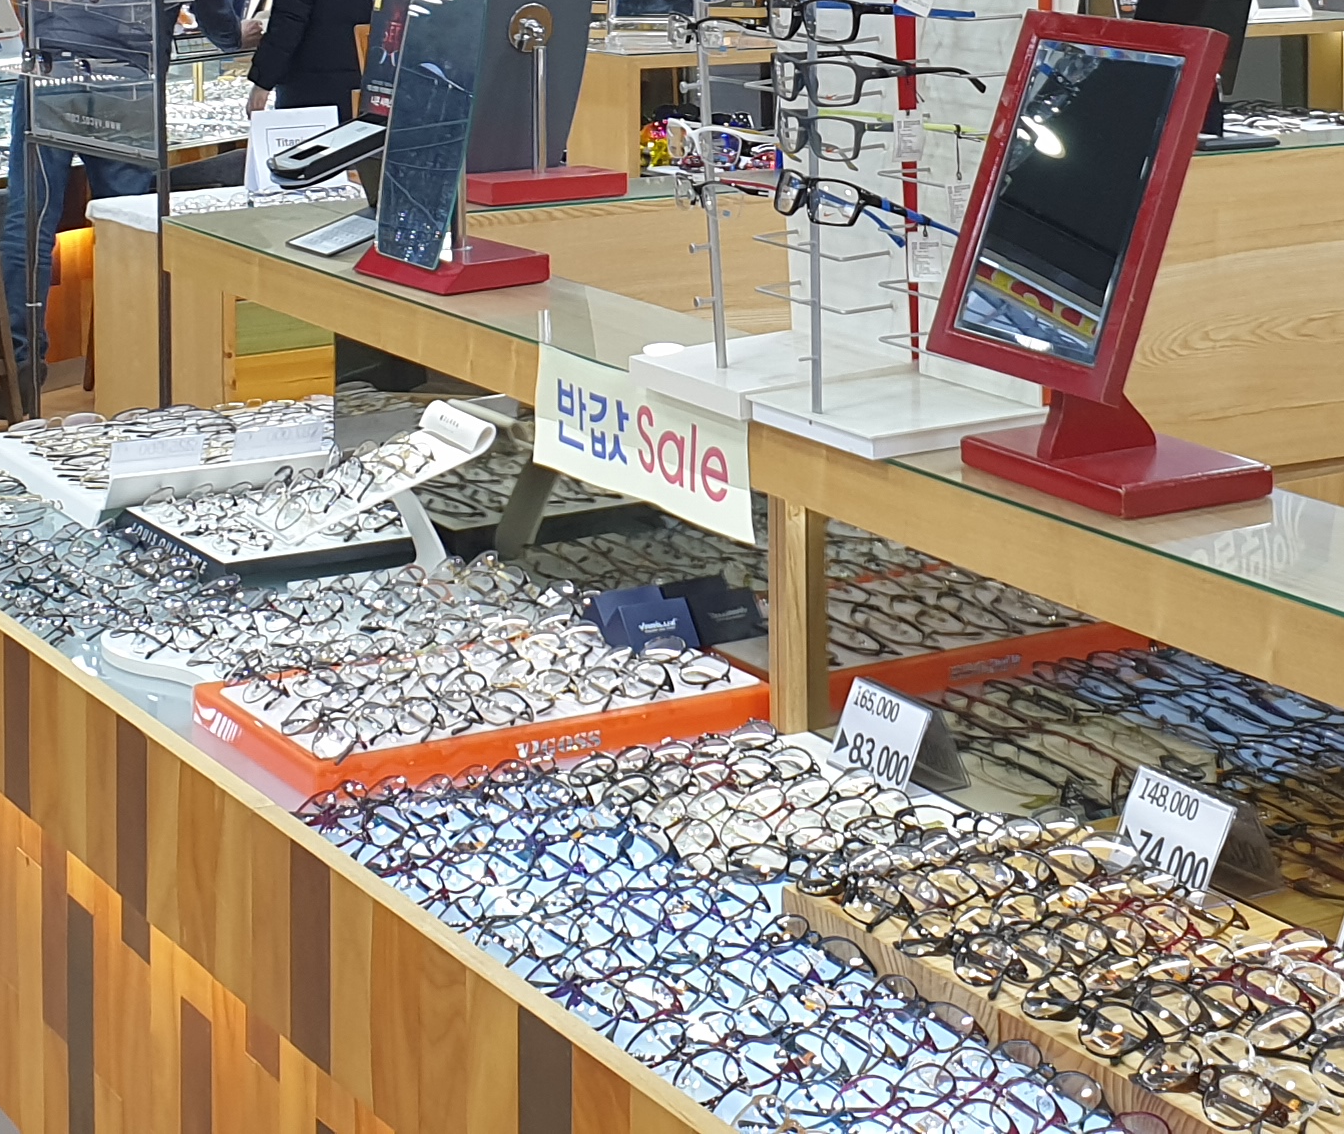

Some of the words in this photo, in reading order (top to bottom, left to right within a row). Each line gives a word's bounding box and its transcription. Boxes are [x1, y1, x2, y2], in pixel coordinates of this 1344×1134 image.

[557, 377, 629, 466] 반값
[636, 404, 729, 502] Sale
[131, 522, 158, 546] LOUIS
[853, 685, 901, 723] 165,000
[848, 732, 910, 786] 83,000
[1138, 777, 1199, 821] 148,000
[1139, 828, 1209, 889] 74000
